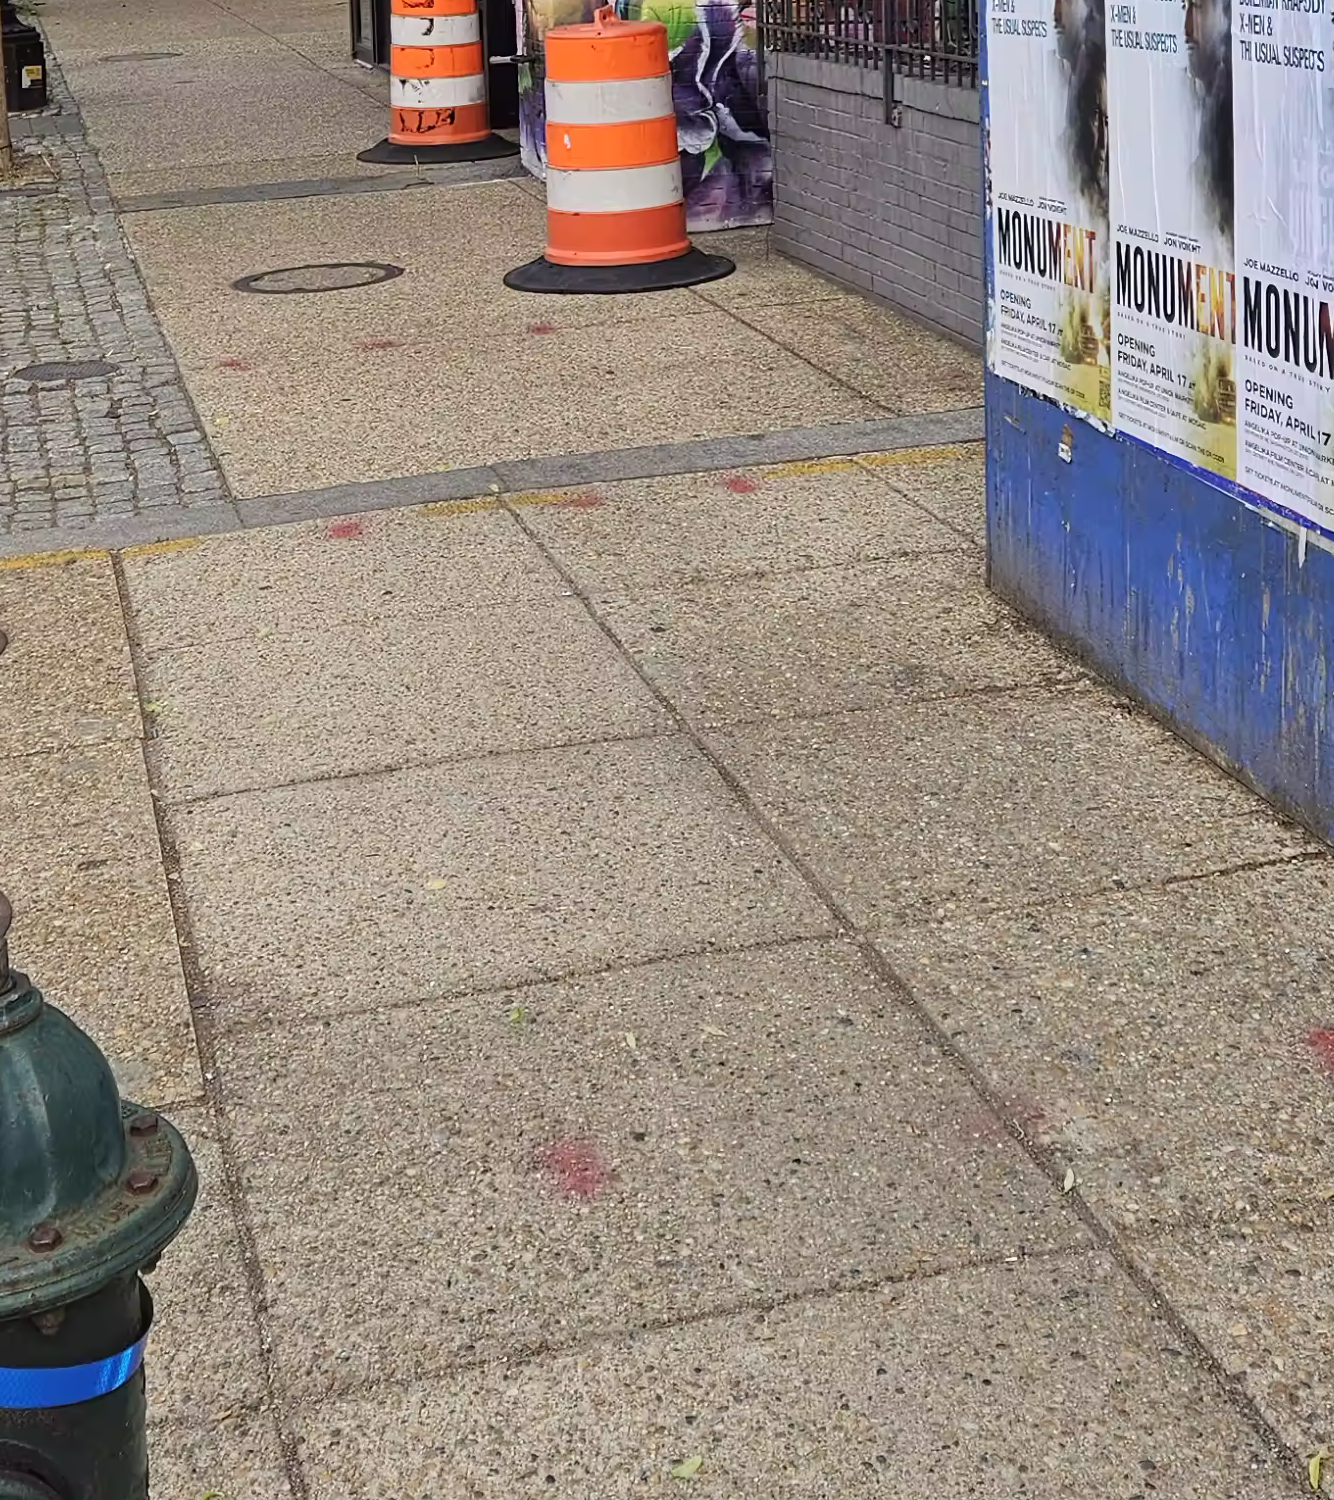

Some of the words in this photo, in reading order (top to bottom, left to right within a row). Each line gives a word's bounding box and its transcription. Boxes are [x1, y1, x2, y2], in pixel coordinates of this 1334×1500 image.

[997, 207, 1096, 293] MONUMENT
[1000, 289, 1031, 310] OPENING
[1116, 241, 1236, 344] MONUMENT
[1117, 333, 1156, 357] OPENING
[1245, 379, 1293, 410] OPENING
[1245, 398, 1283, 428] FRIDAY,
